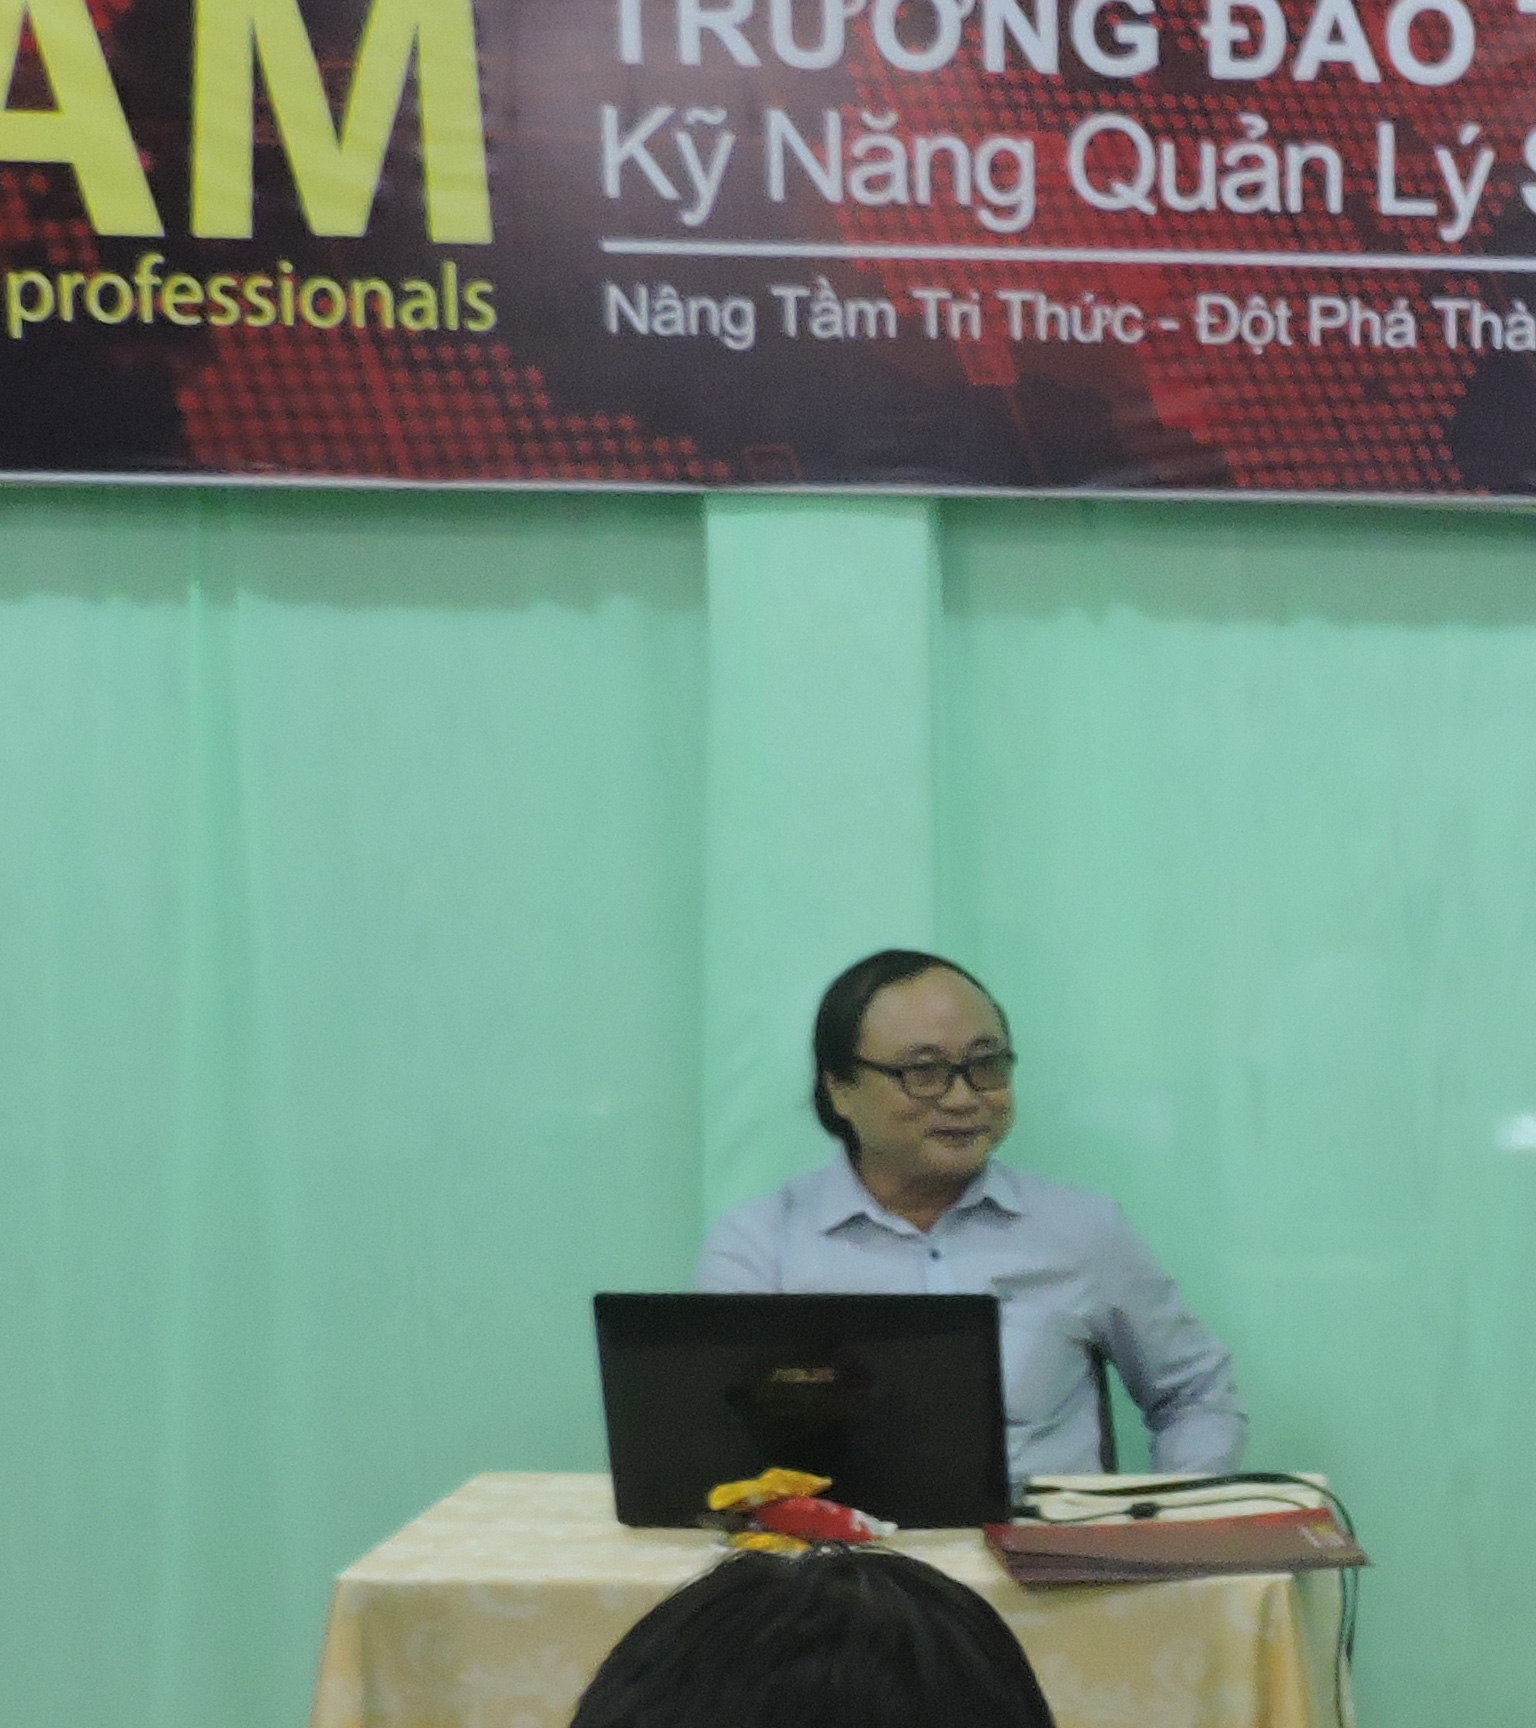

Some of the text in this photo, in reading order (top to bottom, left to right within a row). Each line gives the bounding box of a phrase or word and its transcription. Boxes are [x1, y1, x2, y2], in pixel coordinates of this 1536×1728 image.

[602, 103, 737, 227] Kỹ
[766, 106, 1036, 234] Năng
[1067, 112, 1344, 215] Quản
[1376, 120, 1497, 242] Lý
[4, 253, 498, 338] professionals
[604, 283, 756, 351] Nâng
[996, 287, 1146, 344] Thức
[1195, 293, 1293, 355] Đột
[1307, 296, 1418, 349] Phá
